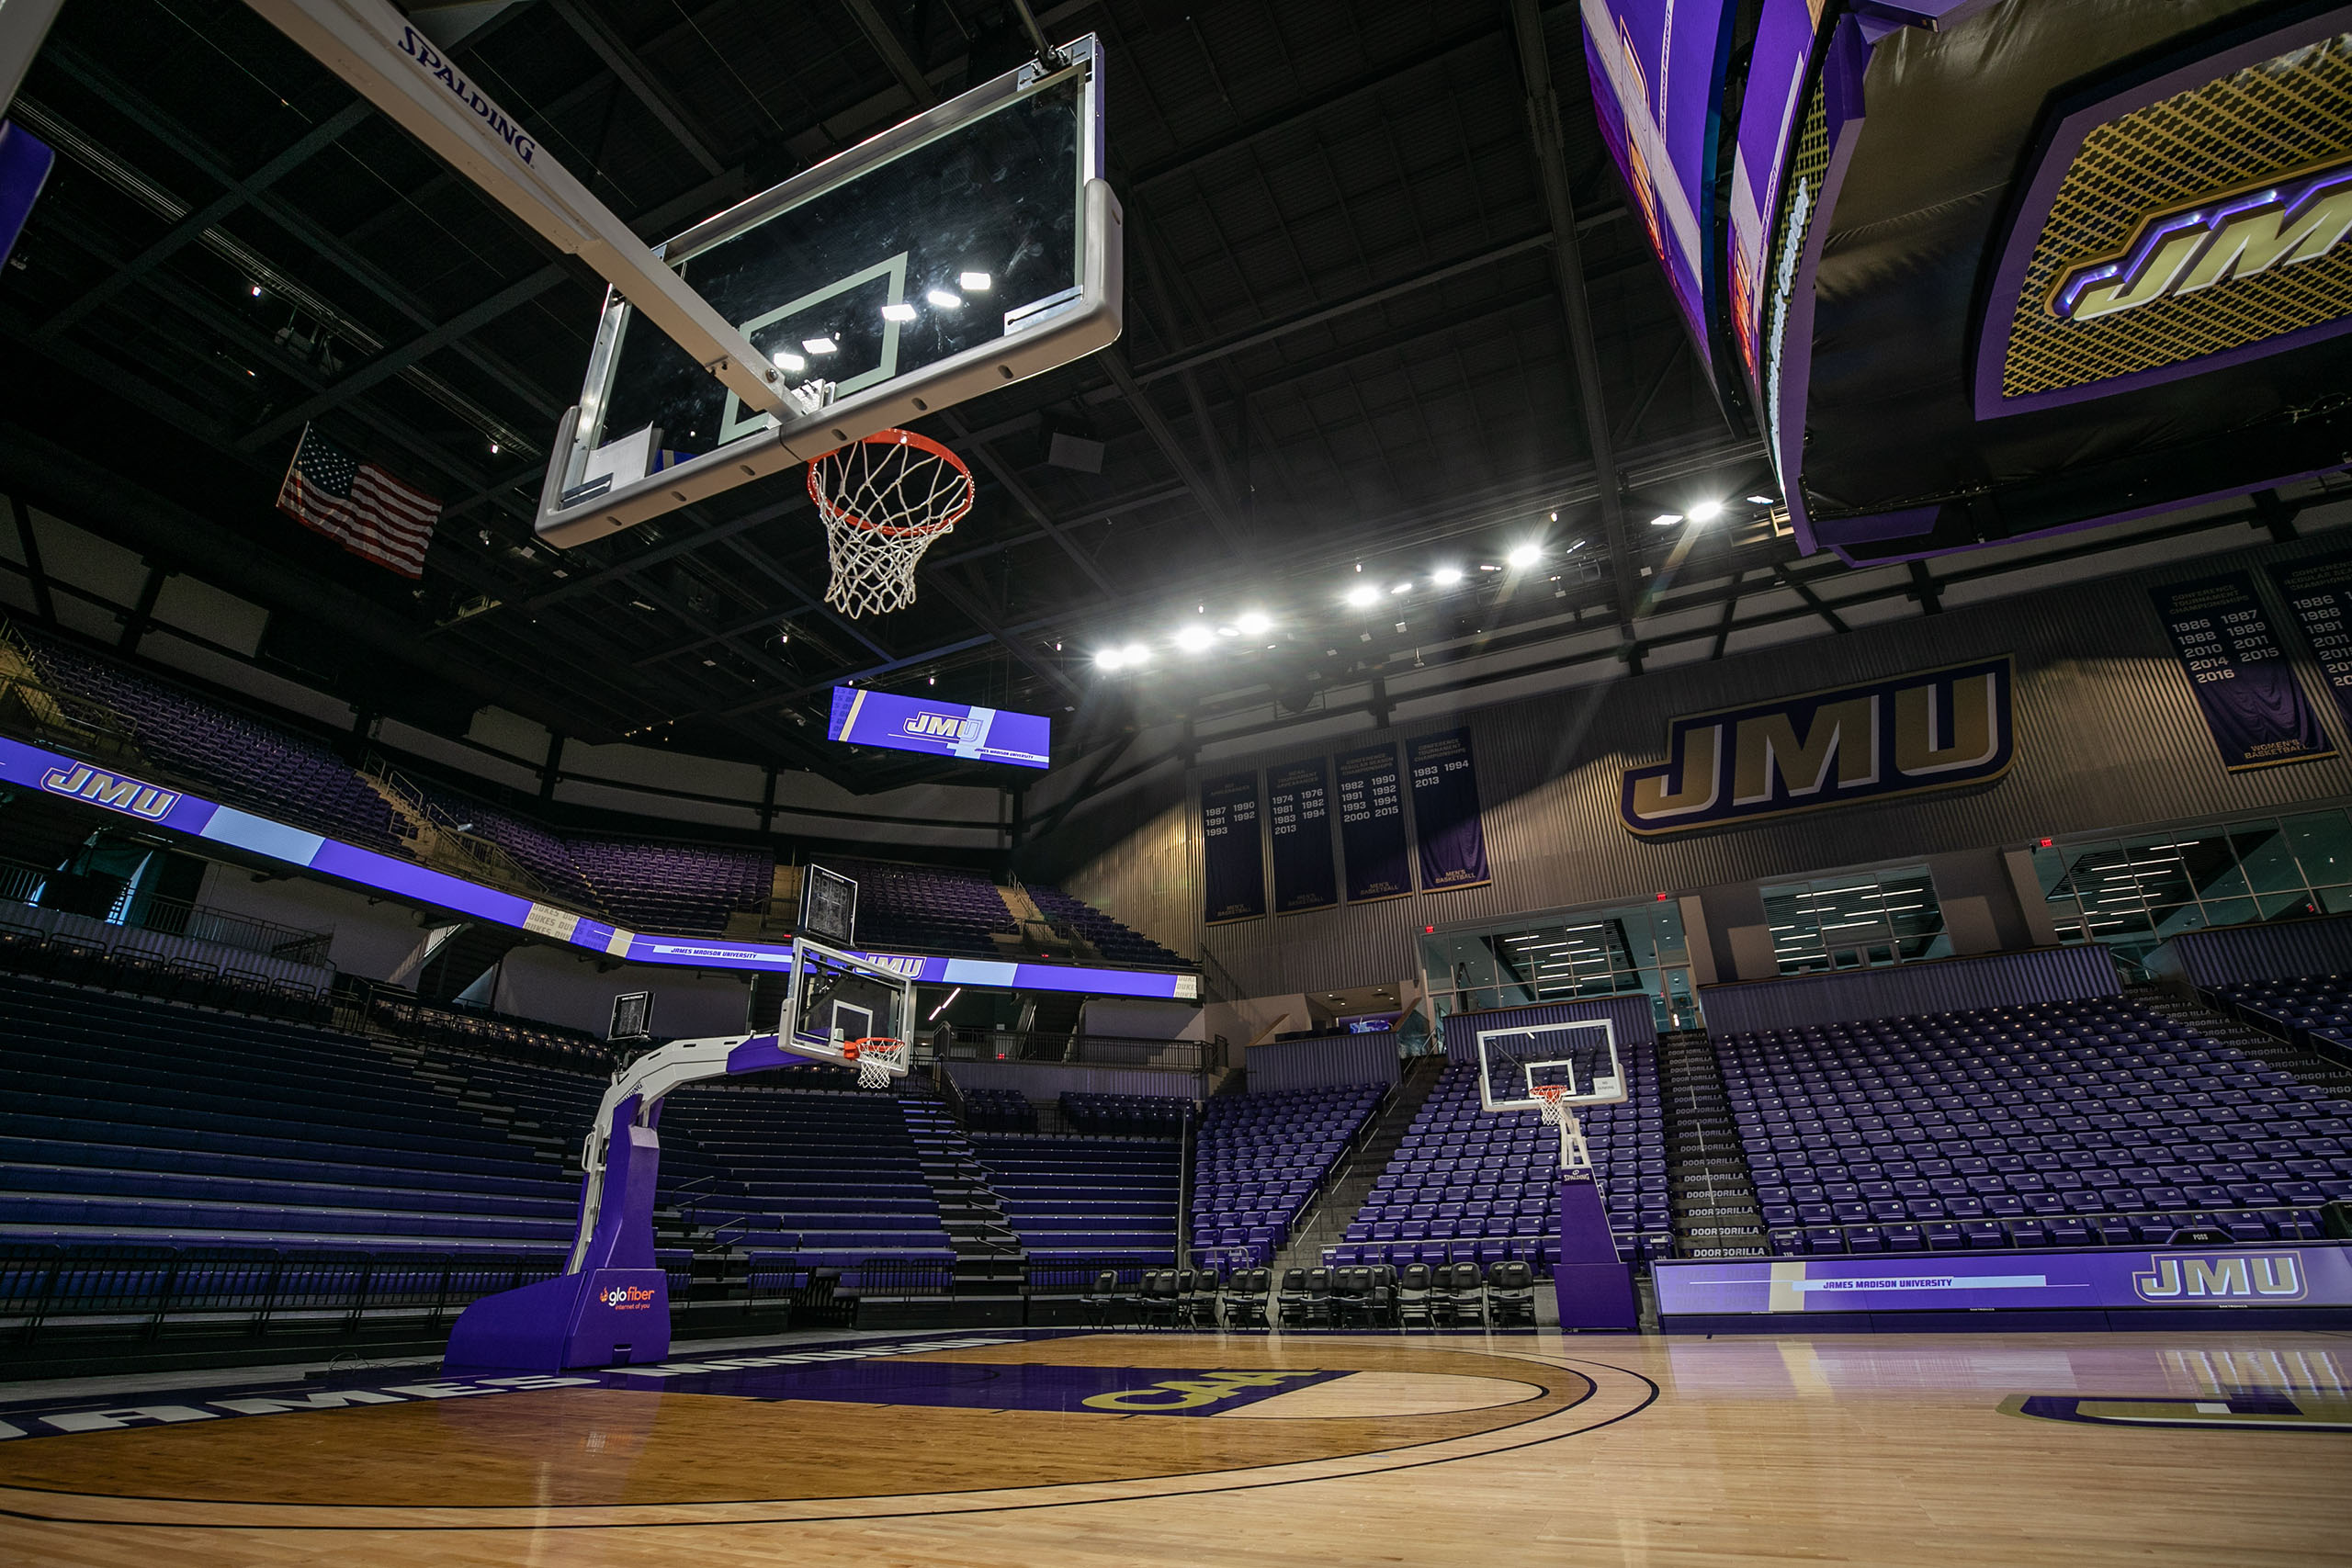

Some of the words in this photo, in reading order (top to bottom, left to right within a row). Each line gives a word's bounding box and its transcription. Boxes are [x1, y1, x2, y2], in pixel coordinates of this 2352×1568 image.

[398, 26, 536, 165] SPALDING
[2074, 189, 2352, 321] JM
[2293, 595, 2335, 610] 1986
[2172, 618, 2211, 633] 1986
[2221, 610, 2258, 625] 1987
[2300, 608, 2341, 622] 1988
[2178, 631, 2217, 645] 1988
[2227, 622, 2266, 637] 1989
[2306, 621, 2344, 635] 1991
[2184, 644, 2223, 658] 2010
[2233, 636, 2269, 649] 2011
[2312, 634, 2350, 648] 2011
[2190, 656, 2230, 671] 2014
[2240, 648, 2279, 662] 2015
[2196, 669, 2235, 683] 2016
[906, 714, 980, 740] JMU
[1633, 671, 1998, 820] JMU
[2245, 745, 2309, 759] BASKETBALL
[2250, 739, 2300, 752] WOMEN'S
[1413, 766, 1438, 777] 1983
[1444, 760, 1469, 773] 1994
[1341, 781, 1364, 792] 1982
[1372, 774, 1396, 785] 1990
[1415, 776, 1440, 788] 2013
[48, 767, 175, 818] JMU
[1272, 795, 1294, 805] 1974
[1301, 788, 1323, 799] 1976
[1342, 792, 1363, 802] 1991
[1373, 784, 1396, 796] 1992
[1206, 807, 1227, 817] 1987
[1233, 801, 1255, 812] 1990
[1273, 805, 1294, 815] 1981
[1302, 798, 1324, 809] 1982
[1343, 801, 1366, 812] 1993
[1374, 795, 1397, 807] 1994
[1206, 817, 1226, 827] 1991
[1234, 811, 1255, 822] 1992
[1274, 815, 1296, 825] 1983
[1303, 808, 1325, 819] 1994
[1344, 811, 1371, 823] 2000
[1374, 806, 1398, 818] 2015
[1206, 827, 1228, 837] 1993
[1274, 825, 1296, 835] 2013
[1435, 873, 1476, 884] BASKETBALL
[1445, 869, 1466, 877] MEN'S
[529, 912, 556, 927] DUKES
[671, 947, 692, 955] JAMES
[693, 949, 722, 957] MADISON
[722, 951, 758, 960] UNIVERSITY
[1823, 1280, 1853, 1290] JAMES
[1855, 1280, 1897, 1290] MADISON
[1899, 1278, 1952, 1288] UNIVERSITY
[2141, 1257, 2300, 1296] JMU
[1081, 1371, 1321, 1411] CAA
